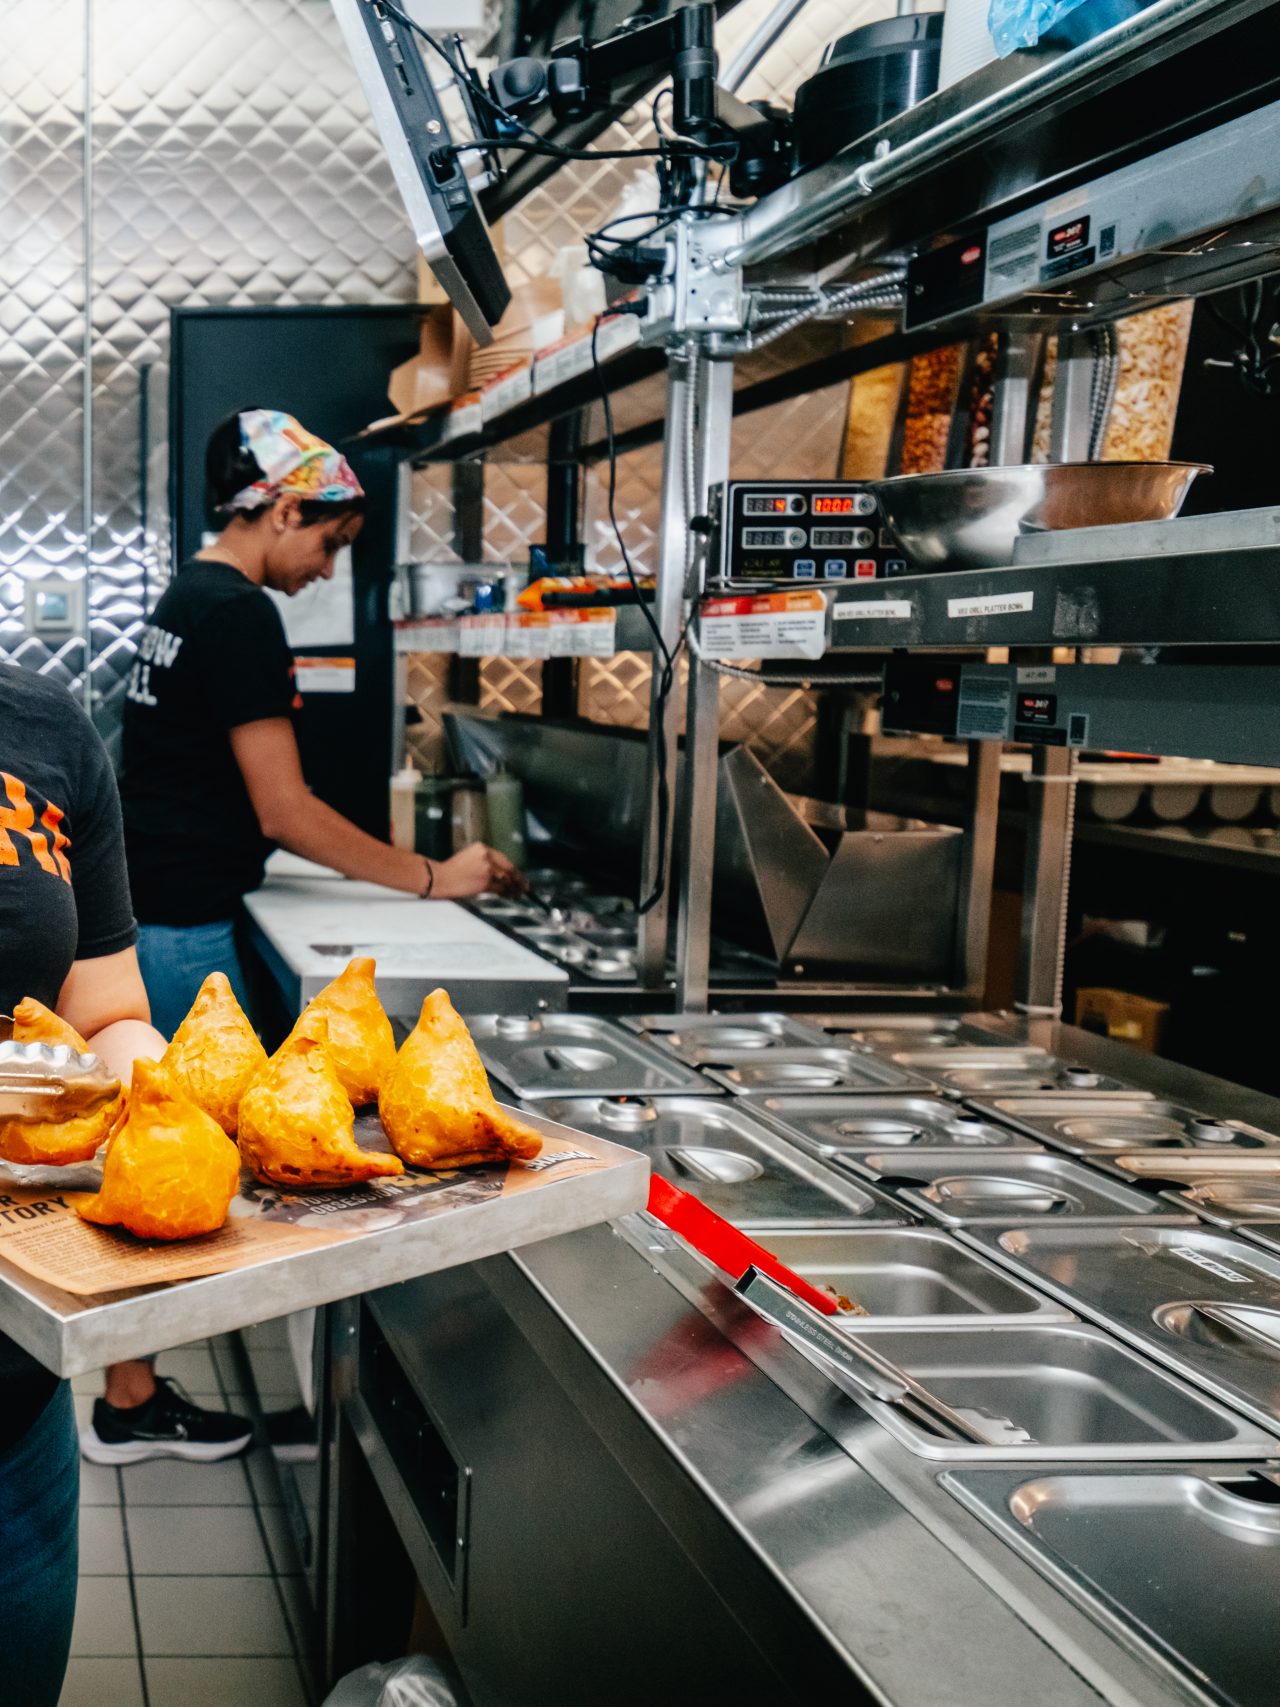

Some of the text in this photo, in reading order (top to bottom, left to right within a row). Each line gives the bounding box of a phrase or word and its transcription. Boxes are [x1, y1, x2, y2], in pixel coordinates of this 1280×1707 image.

[815, 498, 853, 512] 1000
[984, 604, 1007, 613] PLATTER
[309, 1186, 404, 1215] OBSESSION
[785, 1310, 817, 1337] STAINLESS
